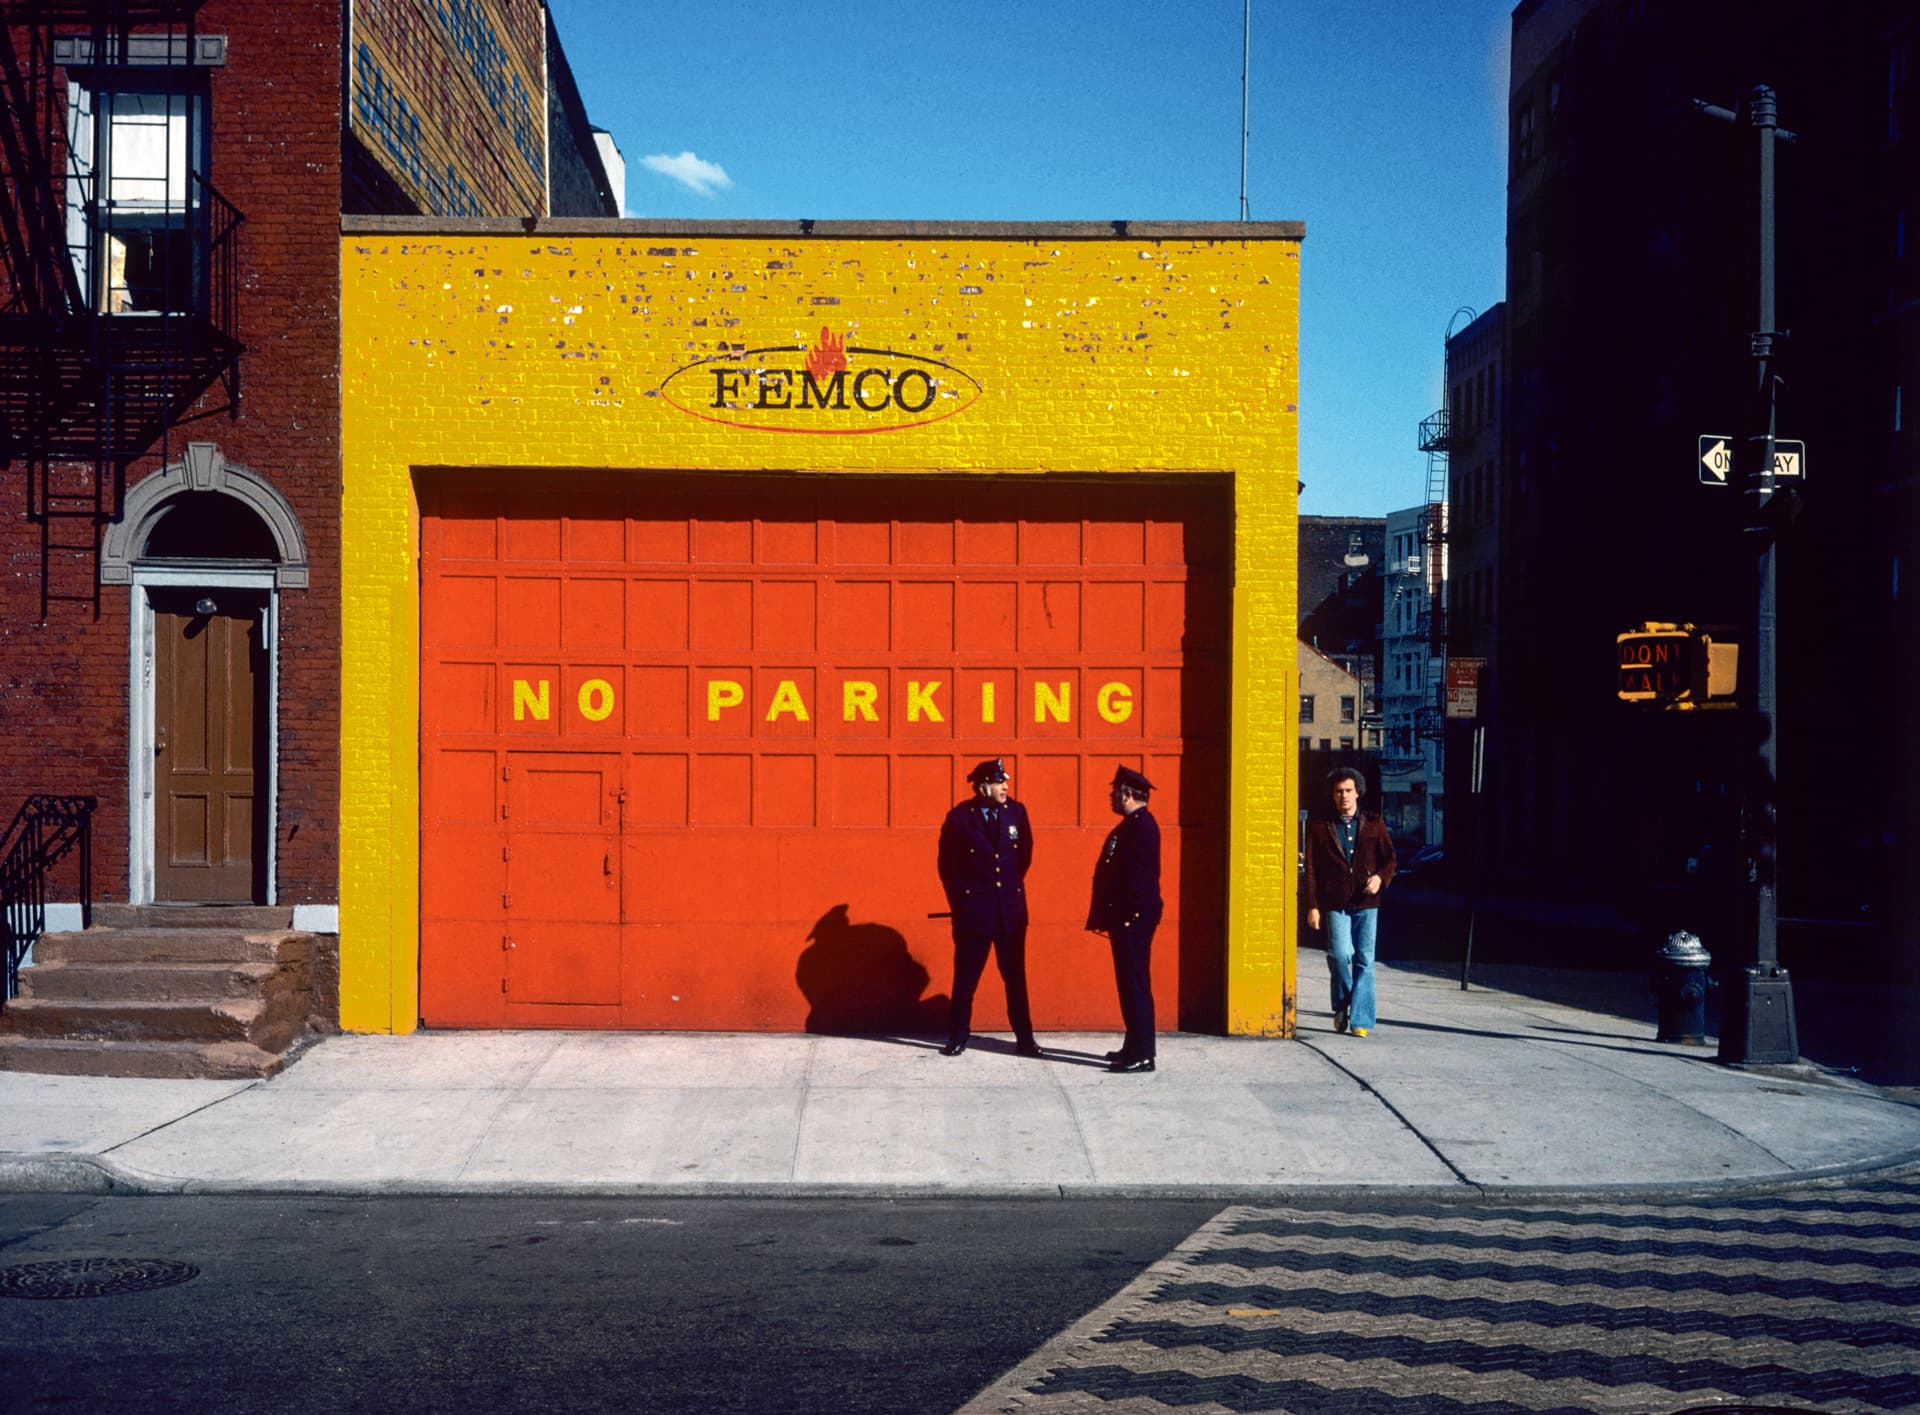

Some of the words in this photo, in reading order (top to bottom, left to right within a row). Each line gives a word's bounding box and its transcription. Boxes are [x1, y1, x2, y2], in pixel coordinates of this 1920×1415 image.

[357, 42, 422, 188] SALES
[709, 367, 937, 413] FEMCO
[1774, 455, 1794, 473] AY
[513, 679, 614, 721] NO
[707, 680, 1133, 723] PARKING
